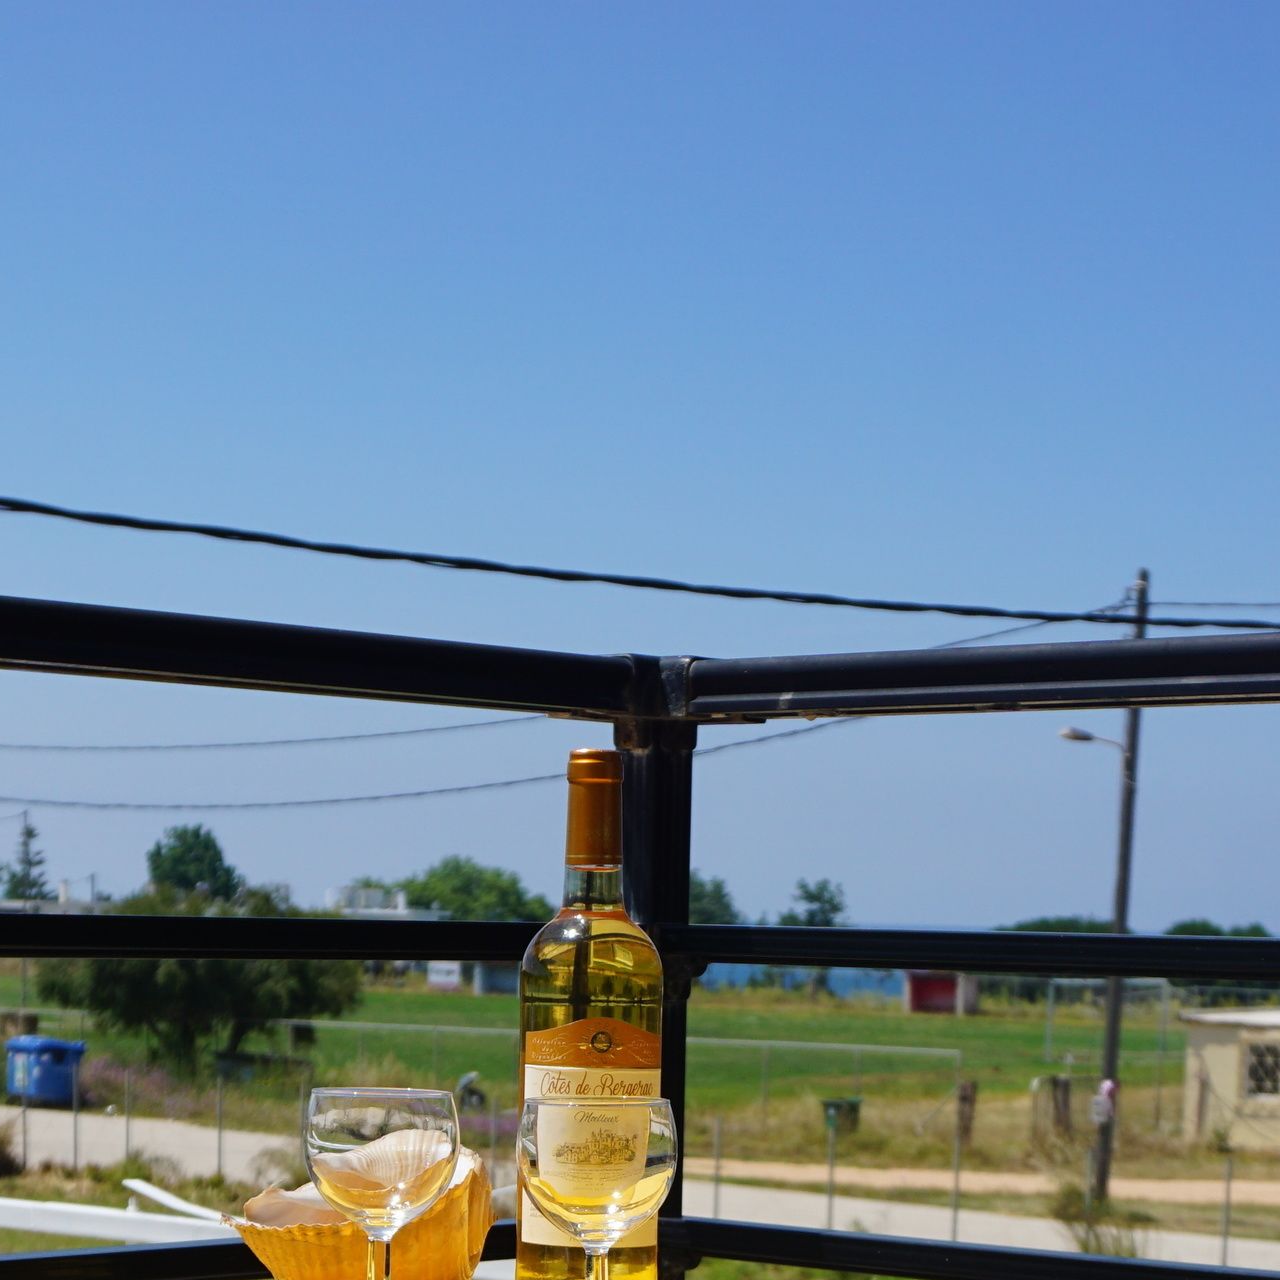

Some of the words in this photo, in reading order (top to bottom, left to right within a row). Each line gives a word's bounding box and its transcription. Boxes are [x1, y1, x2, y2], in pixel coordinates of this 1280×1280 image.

[540, 1071, 572, 1097] Côtes
[575, 1070, 592, 1096] de
[593, 1073, 654, 1097] Bergerac
